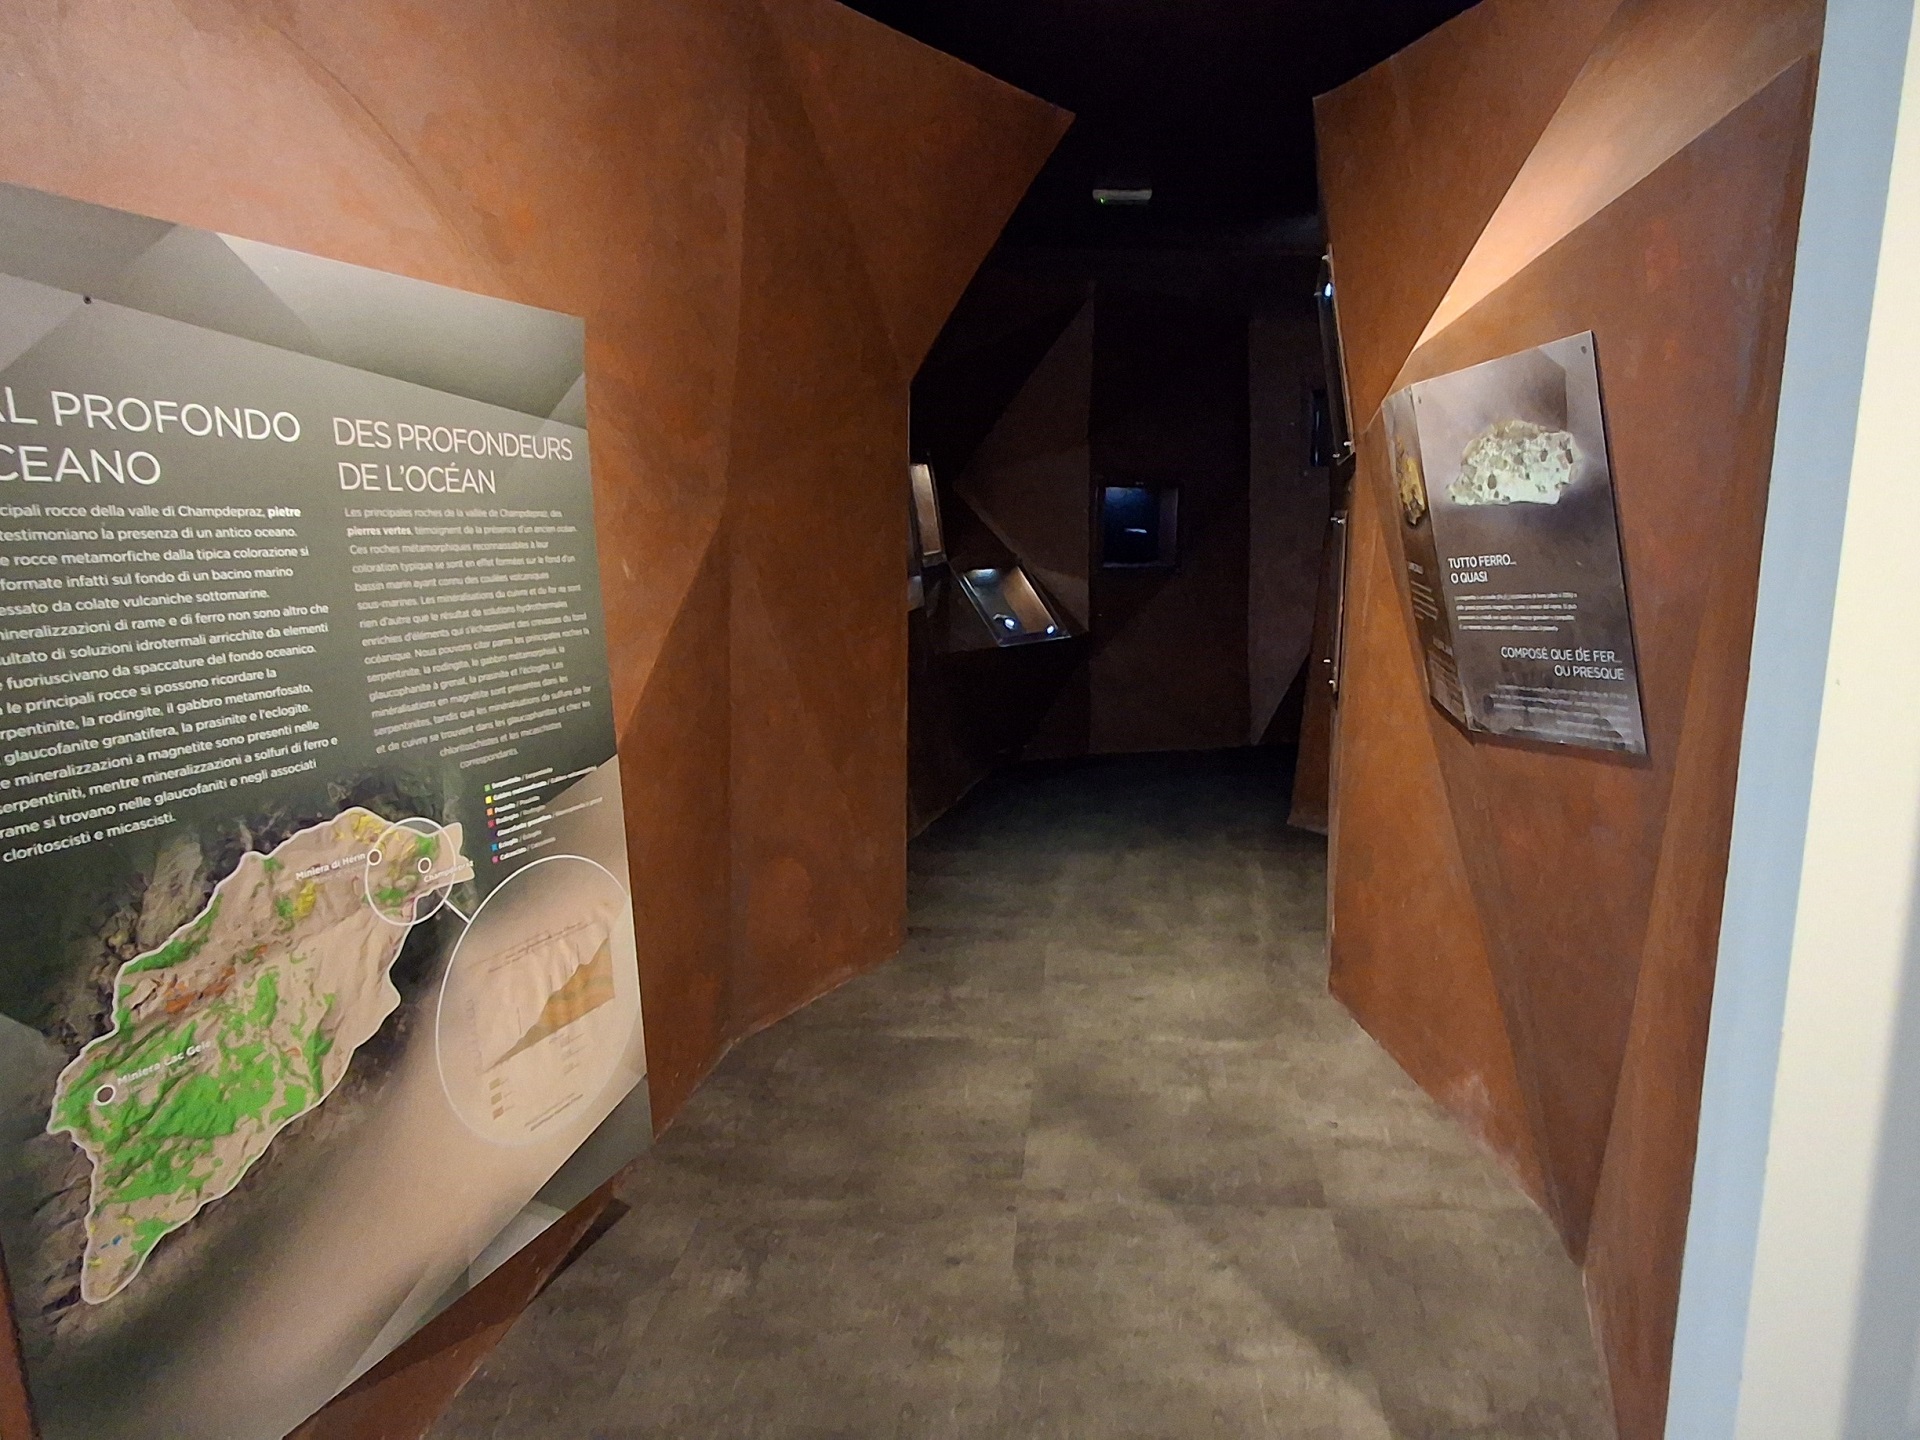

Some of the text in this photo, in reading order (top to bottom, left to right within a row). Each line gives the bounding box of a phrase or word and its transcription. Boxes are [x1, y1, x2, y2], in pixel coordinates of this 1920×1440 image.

[0, 386, 300, 442] L PROFONDO
[333, 417, 573, 461] DES PROFONDEURS
[0, 444, 161, 485] CEANO
[338, 462, 381, 491] DE
[0, 504, 301, 519] cipali rocce della valle di Champdepraz, pietre
[101, 527, 114, 540] la
[117, 530, 178, 541] presenza
[181, 527, 193, 539] di
[196, 530, 212, 539] un
[215, 527, 251, 538] antico
[254, 528, 297, 538] oceano.
[346, 526, 382, 537] pierres
[14, 554, 58, 567] rocce
[61, 550, 160, 564] metamorfiche
[163, 549, 194, 561] dalla
[196, 549, 231, 561] tipica
[233, 547, 298, 559] colorazione
[300, 546, 309, 557] si
[1448, 556, 1477, 569] TUTTO
[0, 566, 293, 591] formate infatti sul fondo di un bacino marino
[1450, 571, 1488, 584] O QUASI
[52, 600, 72, 612] da
[75, 597, 120, 611] colate
[123, 592, 193, 608] vulcaniche
[196, 588, 270, 603] sottomarine.
[114, 619, 128, 631] di
[131, 617, 166, 630] rame
[168, 617, 177, 627] e
[180, 614, 192, 626] di
[195, 612, 225, 624] ferro
[228, 611, 250, 622] non
[253, 609, 280, 620] sono
[283, 605, 308, 616] altro
[310, 603, 329, 615] che
[0, 623, 329, 667] ultato di soluzioni idrotermali arricchite da elementi
[1550, 648, 1573, 661] QUE
[6, 645, 316, 690] fuoriuscivano da spaccature del fondo oceanico.
[1554, 664, 1625, 681] OU PRESQUE
[7, 668, 277, 715] le principali rocce si possono ricordare la
[82, 716, 96, 728] la
[166, 703, 174, 714] il
[177, 697, 223, 715] gabbro
[225, 683, 313, 706] metamorfosato,
[4, 739, 99, 767] glaucofanite
[102, 726, 179, 749] granatifera,
[181, 722, 193, 733] la
[195, 713, 247, 733] prasinite
[250, 711, 257, 722] e
[14, 754, 133, 787] mineralizzazioni
[136, 752, 145, 764] a
[148, 742, 213, 762] magnetite
[215, 735, 245, 749] sono
[247, 724, 292, 744] presenti
[295, 720, 320, 733] nelle
[89, 777, 140, 796] mentre
[142, 754, 242, 784] mineralizzazioni
[244, 754, 252, 764] a
[254, 746, 288, 762] solfuri
[291, 742, 302, 753] di
[304, 738, 329, 751] ferro
[331, 736, 338, 746] e
[0, 758, 317, 840] rame si trovano nelle glaucofaniti e negli associati
[2, 811, 176, 863] cloritoscisti e micascisti.
